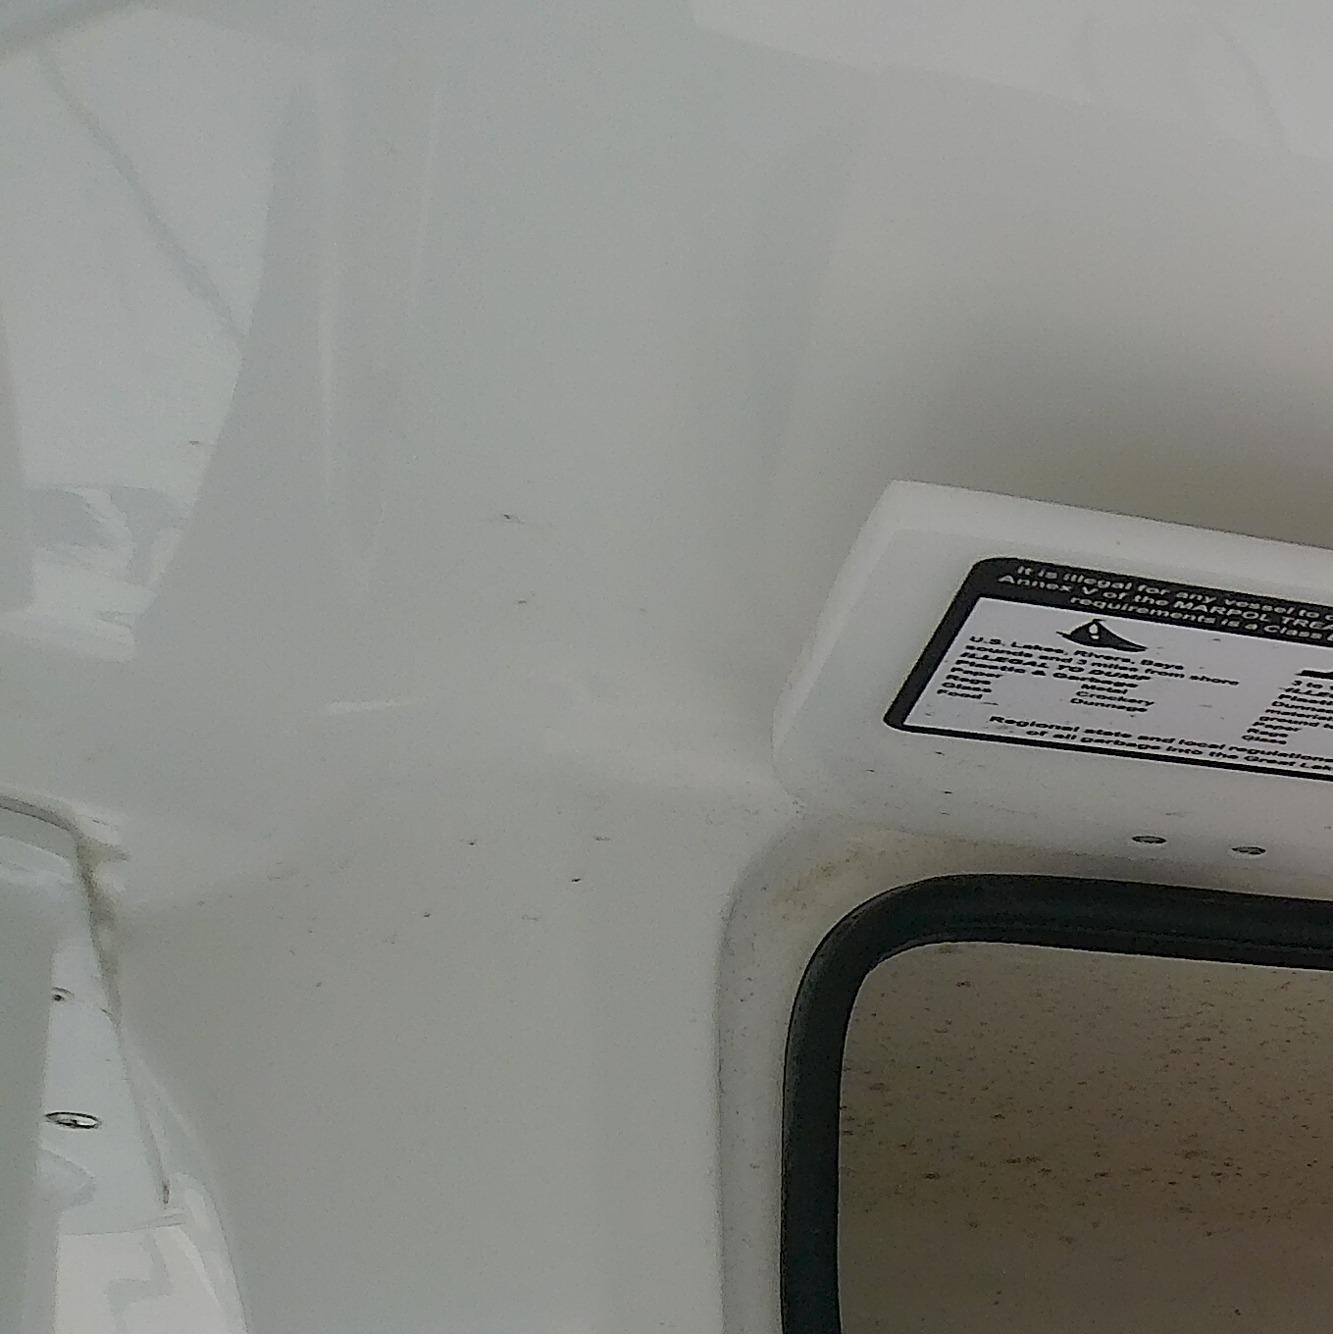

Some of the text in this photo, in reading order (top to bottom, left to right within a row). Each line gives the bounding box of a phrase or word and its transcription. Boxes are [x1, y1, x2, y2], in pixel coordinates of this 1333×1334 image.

[998, 575, 1071, 591] Annex
[1133, 595, 1168, 605] the
[1173, 601, 1268, 621] MARPOL
[1063, 573, 1131, 589] illegal
[1137, 584, 1169, 594] for
[1176, 592, 1216, 603] any
[1224, 599, 1294, 613] vessel
[1298, 609, 1319, 617] to
[1071, 597, 1214, 623] requirements
[1264, 625, 1321, 638] Class
[960, 652, 1150, 680] ILLEGAL TO DUMP
